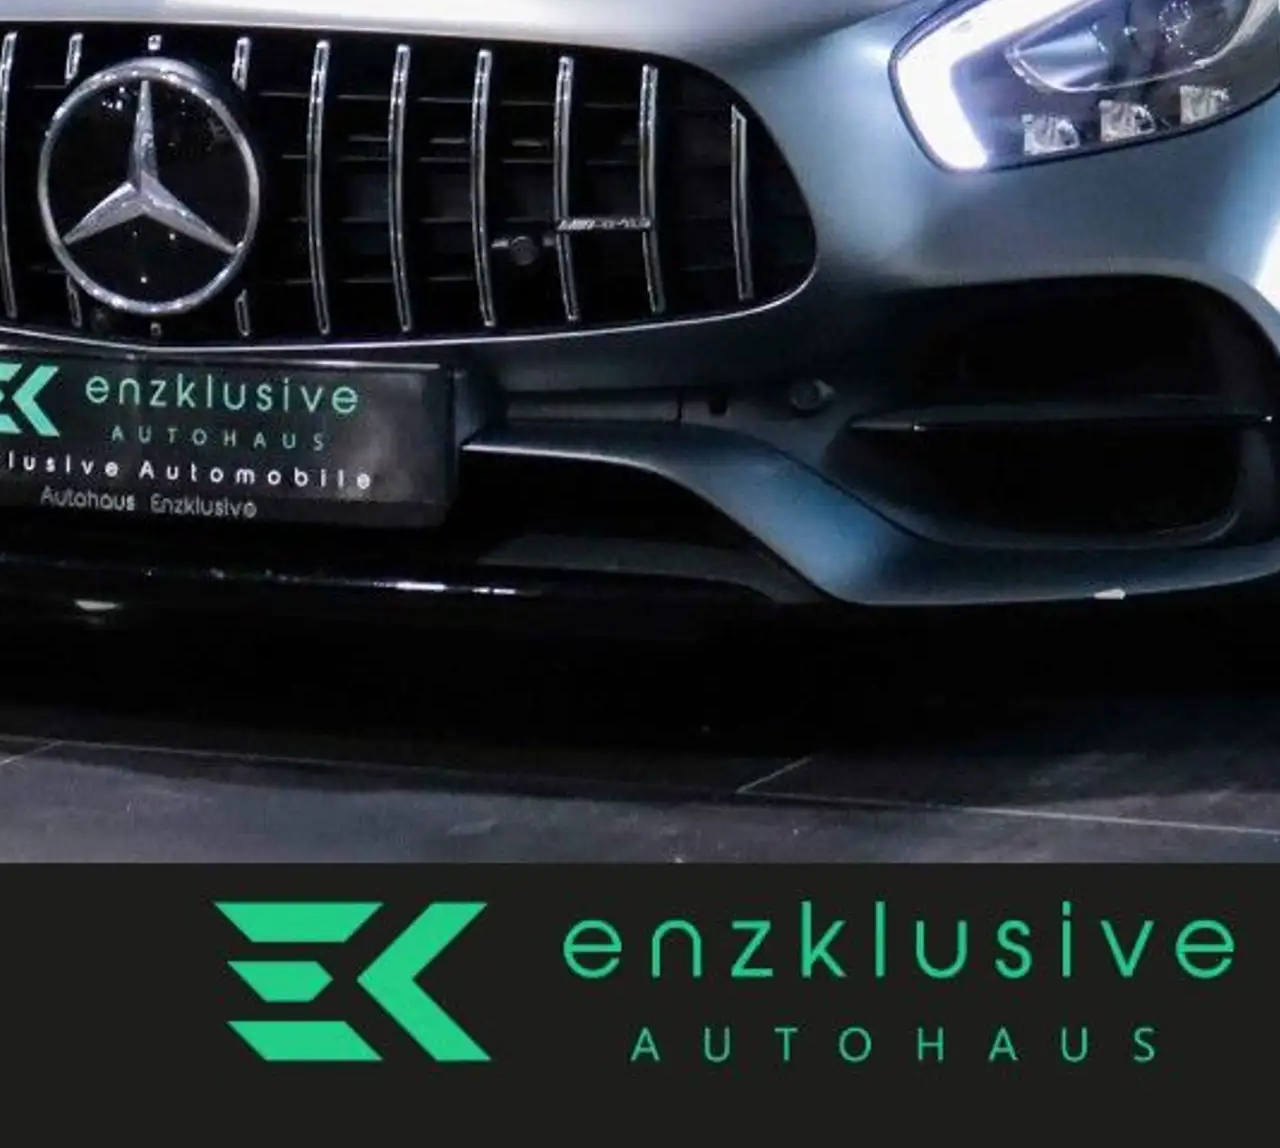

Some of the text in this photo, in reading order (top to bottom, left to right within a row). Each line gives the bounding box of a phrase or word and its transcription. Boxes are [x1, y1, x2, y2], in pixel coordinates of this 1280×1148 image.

[85, 373, 360, 415] enzklusive
[111, 425, 325, 452] AUTOHAUS
[139, 460, 371, 490] Automobile
[40, 485, 258, 519] Autohaus Enzklusive
